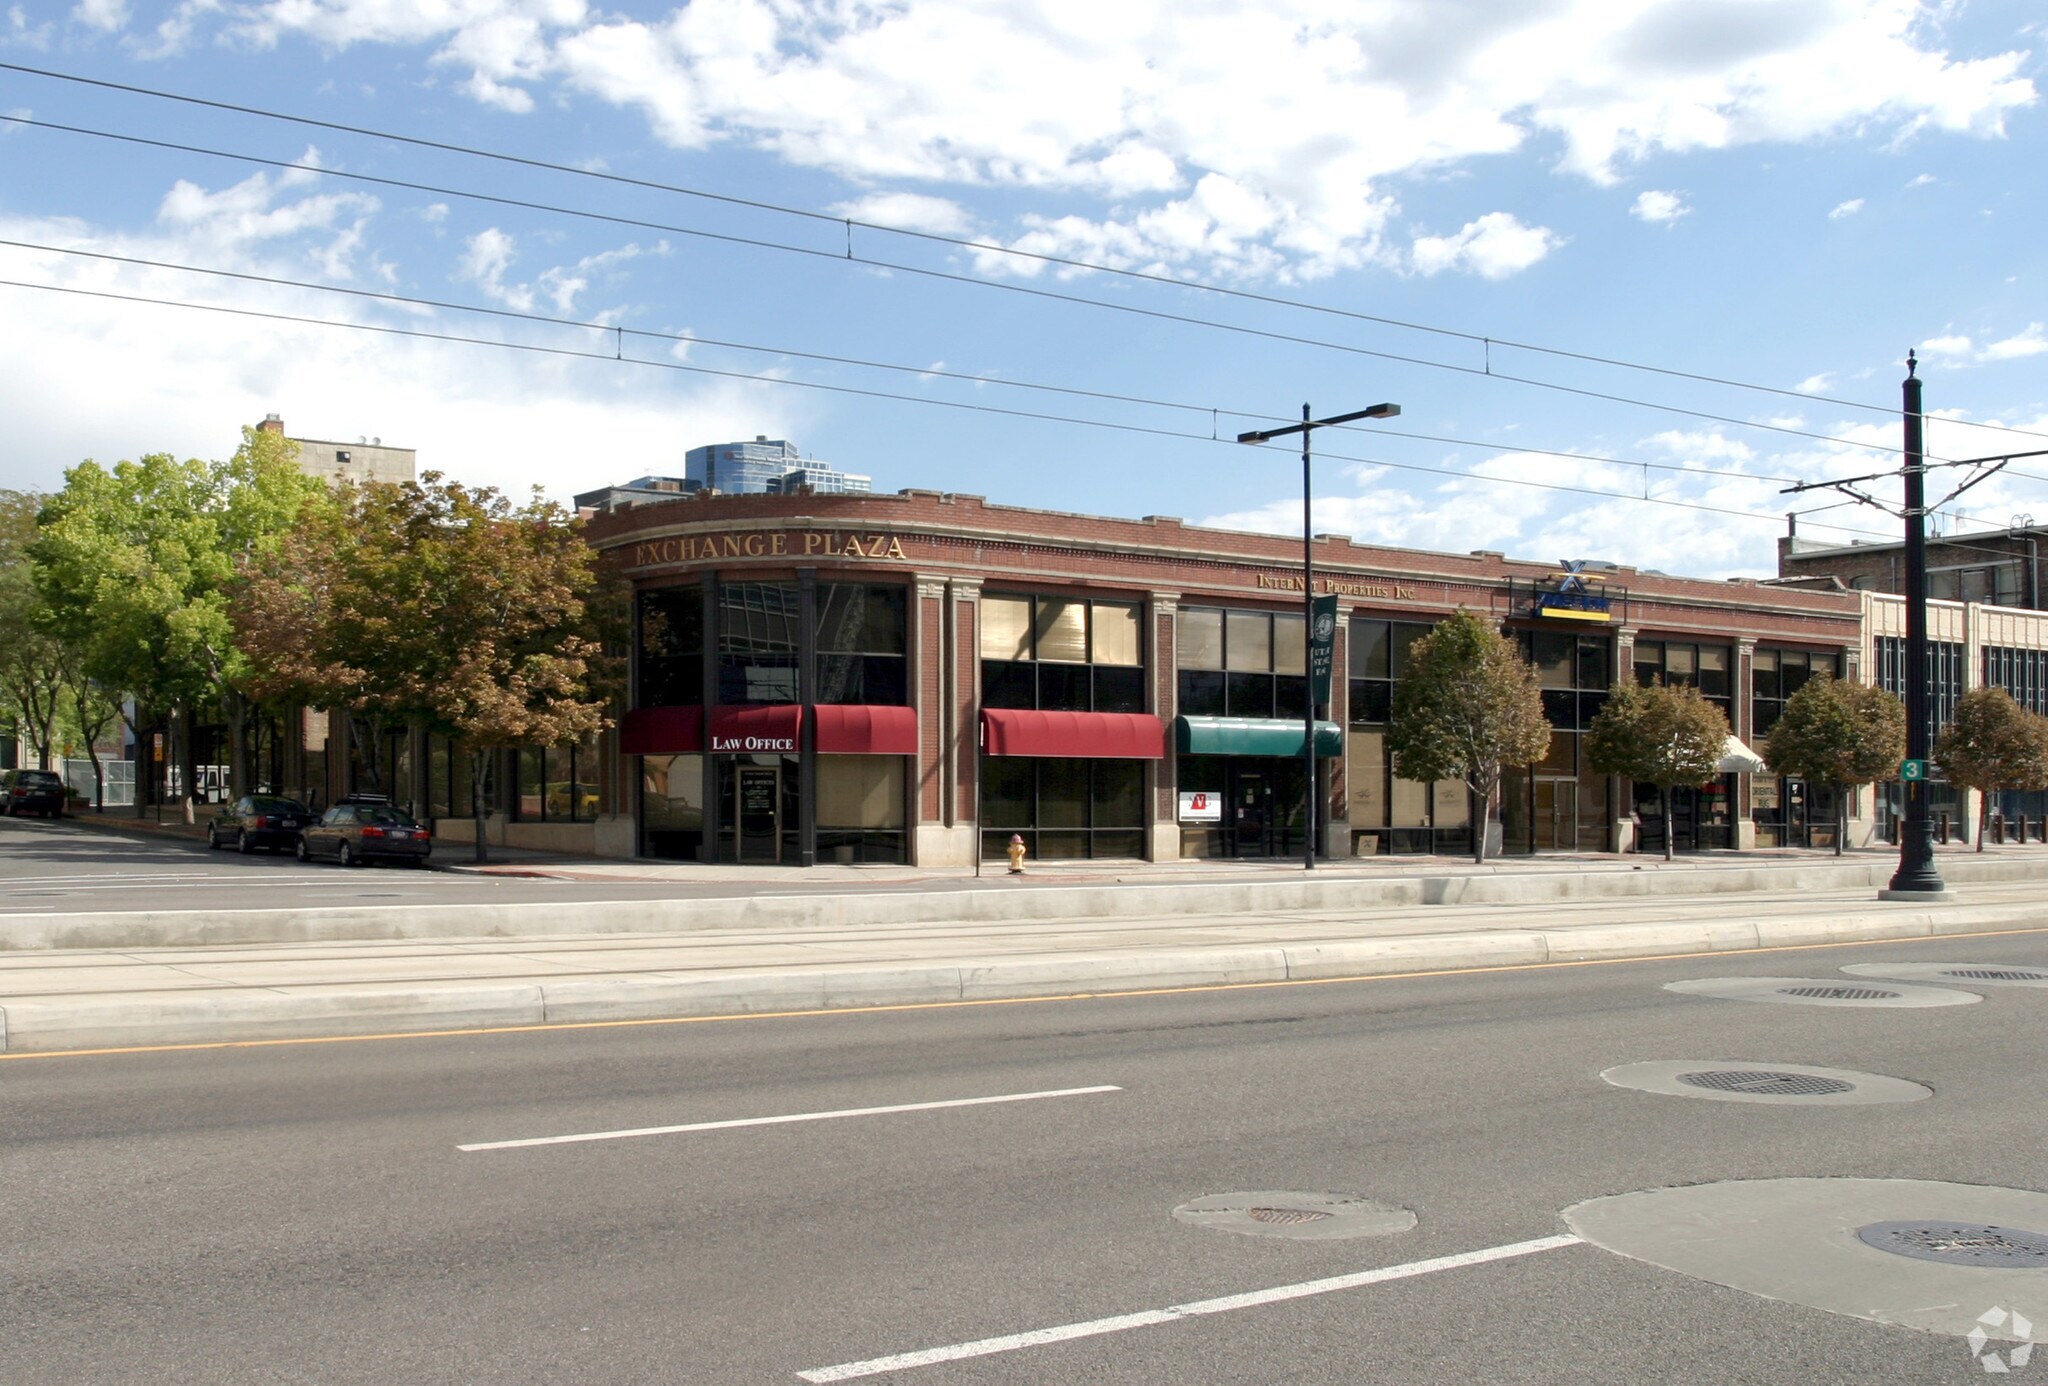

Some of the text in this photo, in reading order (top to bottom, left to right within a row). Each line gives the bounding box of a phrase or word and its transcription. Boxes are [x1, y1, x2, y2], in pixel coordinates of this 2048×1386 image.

[636, 533, 907, 566] EXCHANGE PLAZA
[1258, 573, 1318, 591] INTERNT
[1325, 579, 1389, 598] PROPERTIES
[712, 736, 794, 750] LAW OFFICE
[1905, 761, 1918, 778] 3
